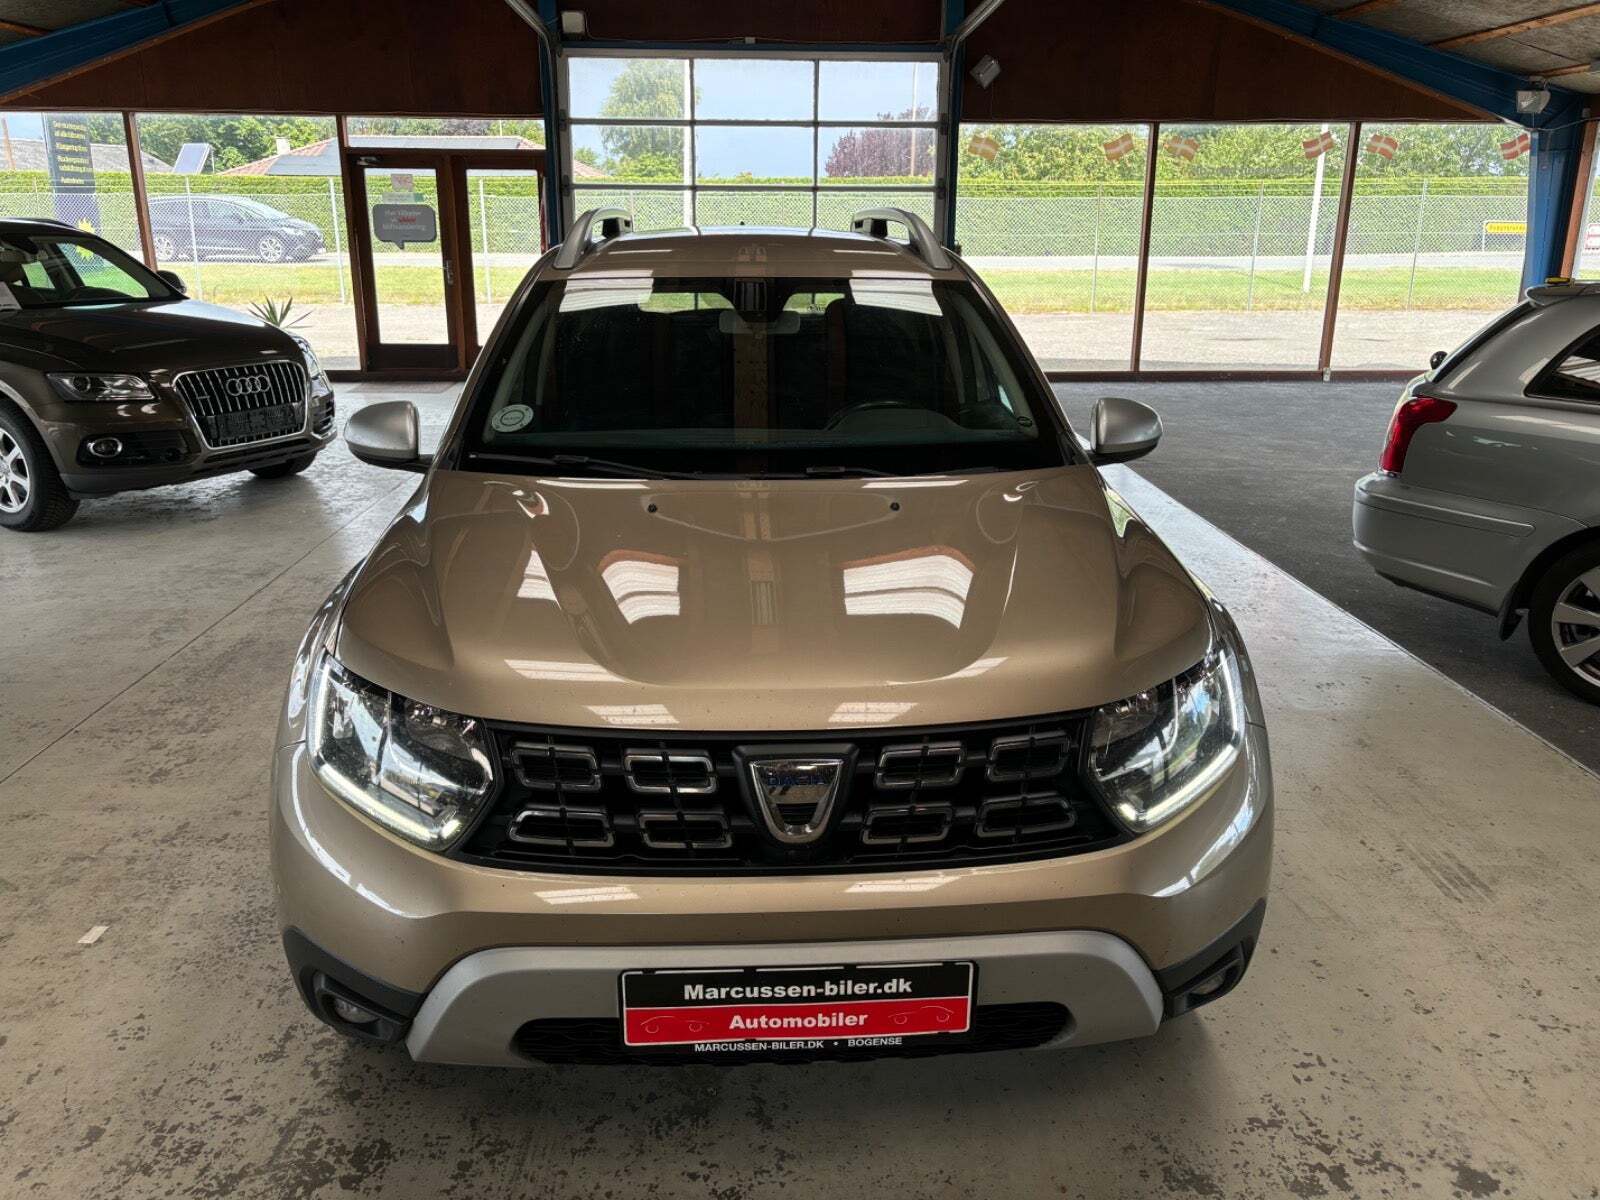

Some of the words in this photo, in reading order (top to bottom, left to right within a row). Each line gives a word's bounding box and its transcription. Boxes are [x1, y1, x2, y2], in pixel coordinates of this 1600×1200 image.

[684, 977, 913, 1000] Marcussen-biler.dk
[729, 1012, 869, 1030] Automobiler
[694, 1040, 824, 1052] MARCUSSEN-BILER.DK
[848, 1036, 903, 1047] BOGENSE
